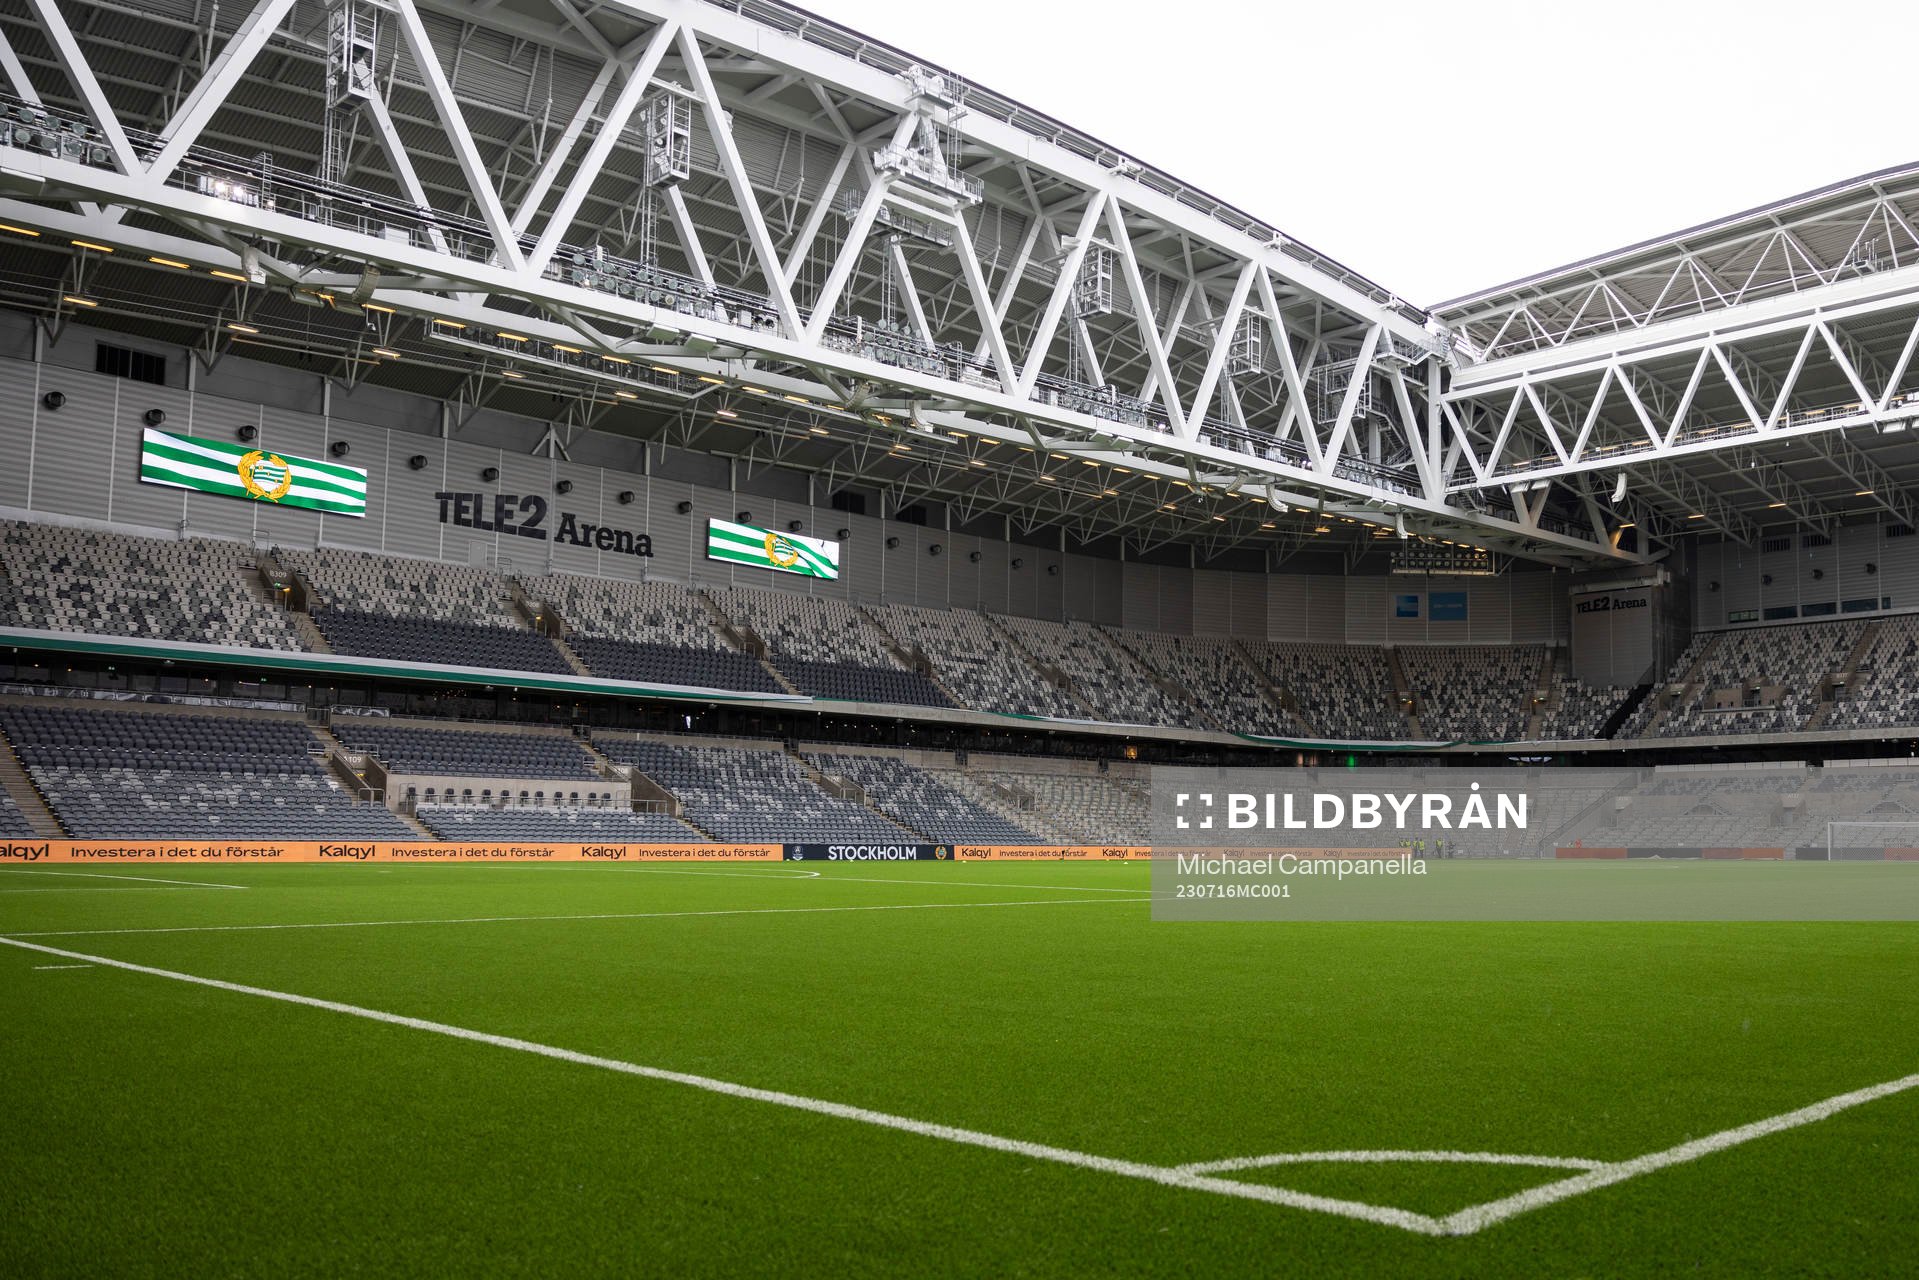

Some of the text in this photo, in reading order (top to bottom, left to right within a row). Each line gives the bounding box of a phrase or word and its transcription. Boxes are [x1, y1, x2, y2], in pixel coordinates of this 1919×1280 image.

[435, 492, 654, 557] TELE2 Arena
[1576, 596, 1647, 614] TELE2 Arena
[0, 843, 284, 860] alqyl Investera i det du förstår
[319, 844, 555, 860] Kalqyl Investera i det du förstår
[581, 846, 771, 860] Kalqyl Investera i det du förstår
[828, 845, 917, 861] STOCKHOLM
[961, 847, 992, 859] Kalqyl
[999, 849, 1034, 857] Investera
[1039, 849, 1051, 857] det
[1052, 849, 1061, 857] du
[1102, 848, 1128, 859] Kalqyl
